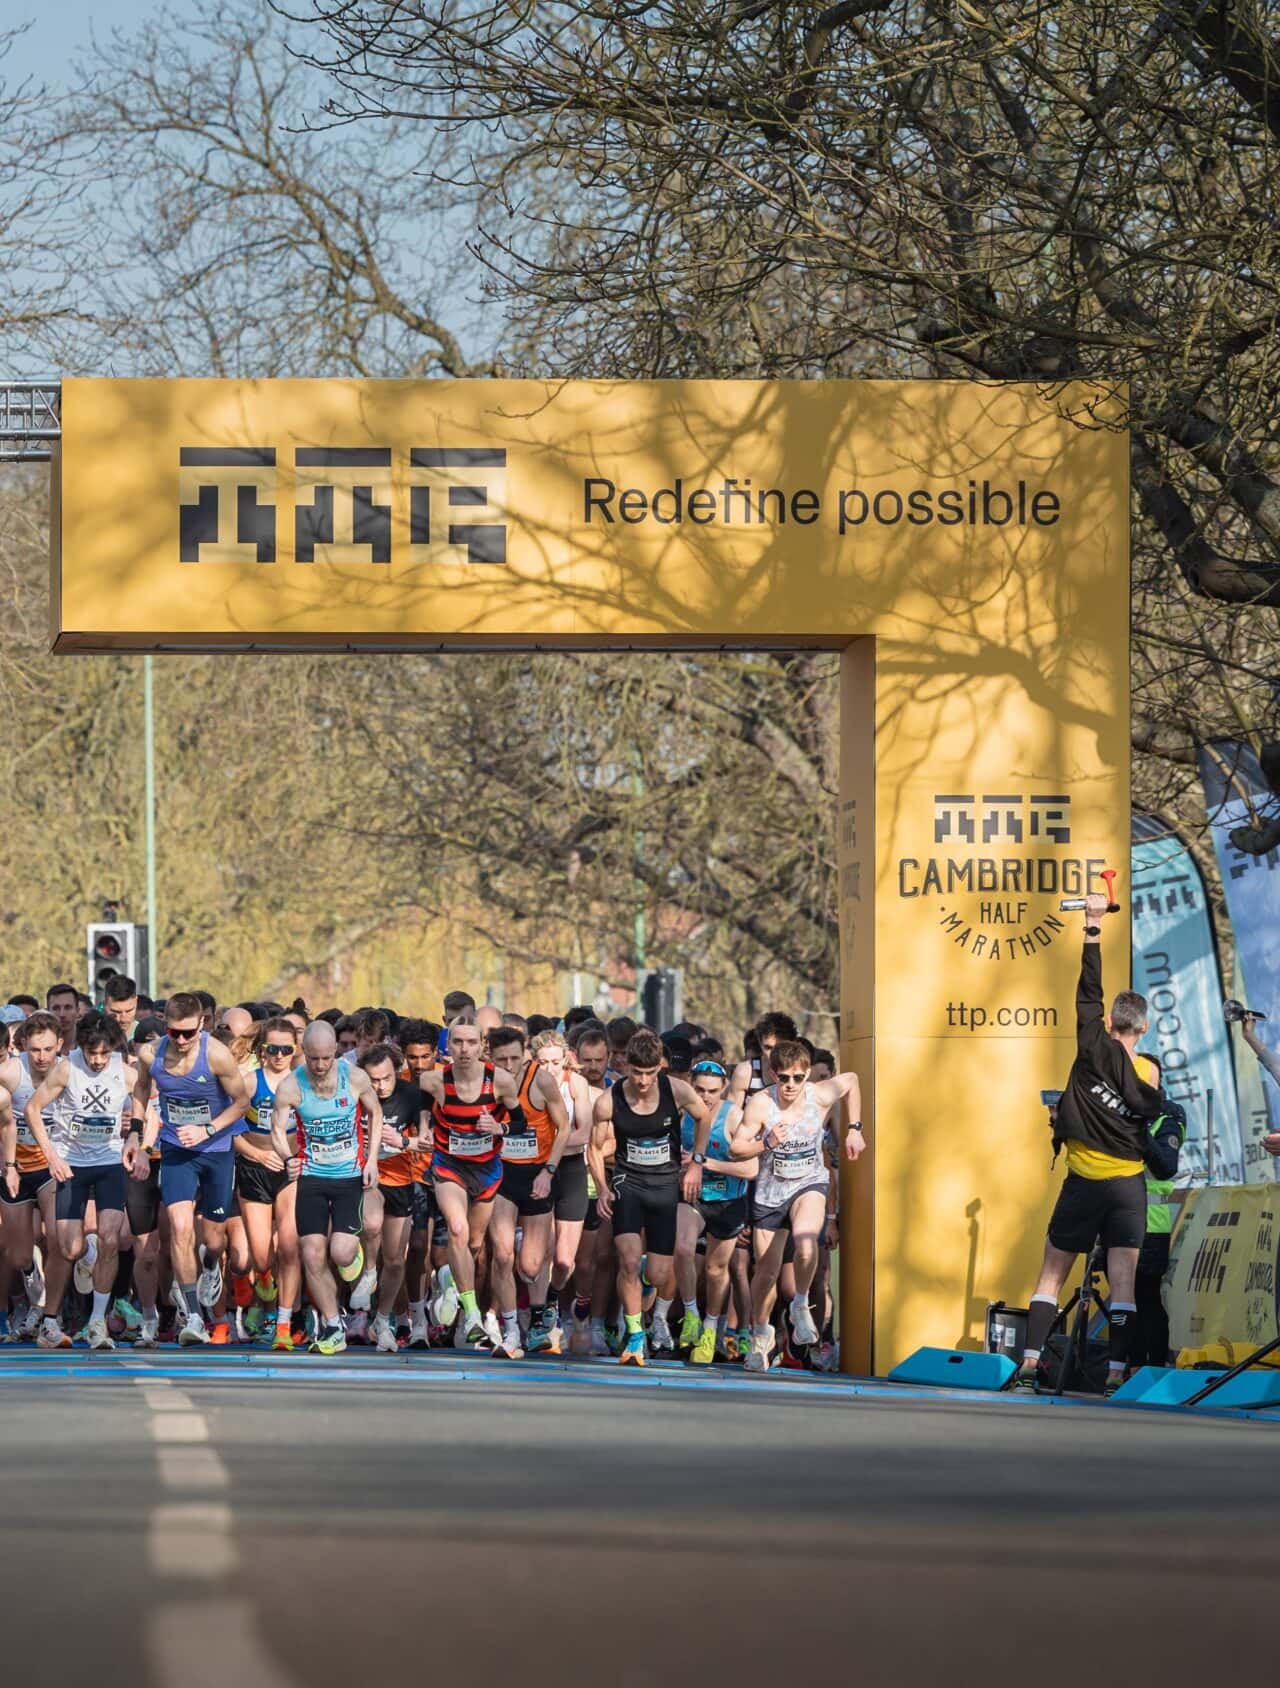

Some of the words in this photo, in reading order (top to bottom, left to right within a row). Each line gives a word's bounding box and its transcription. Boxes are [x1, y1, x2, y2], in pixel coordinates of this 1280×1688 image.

[583, 477, 819, 525] Redefine
[838, 480, 1061, 535] possible
[898, 858, 1106, 898] CAMBRIDGE
[980, 902, 1028, 924] HALF
[939, 911, 1065, 961] MARATHON
[946, 1001, 1058, 1031] ttp.com
